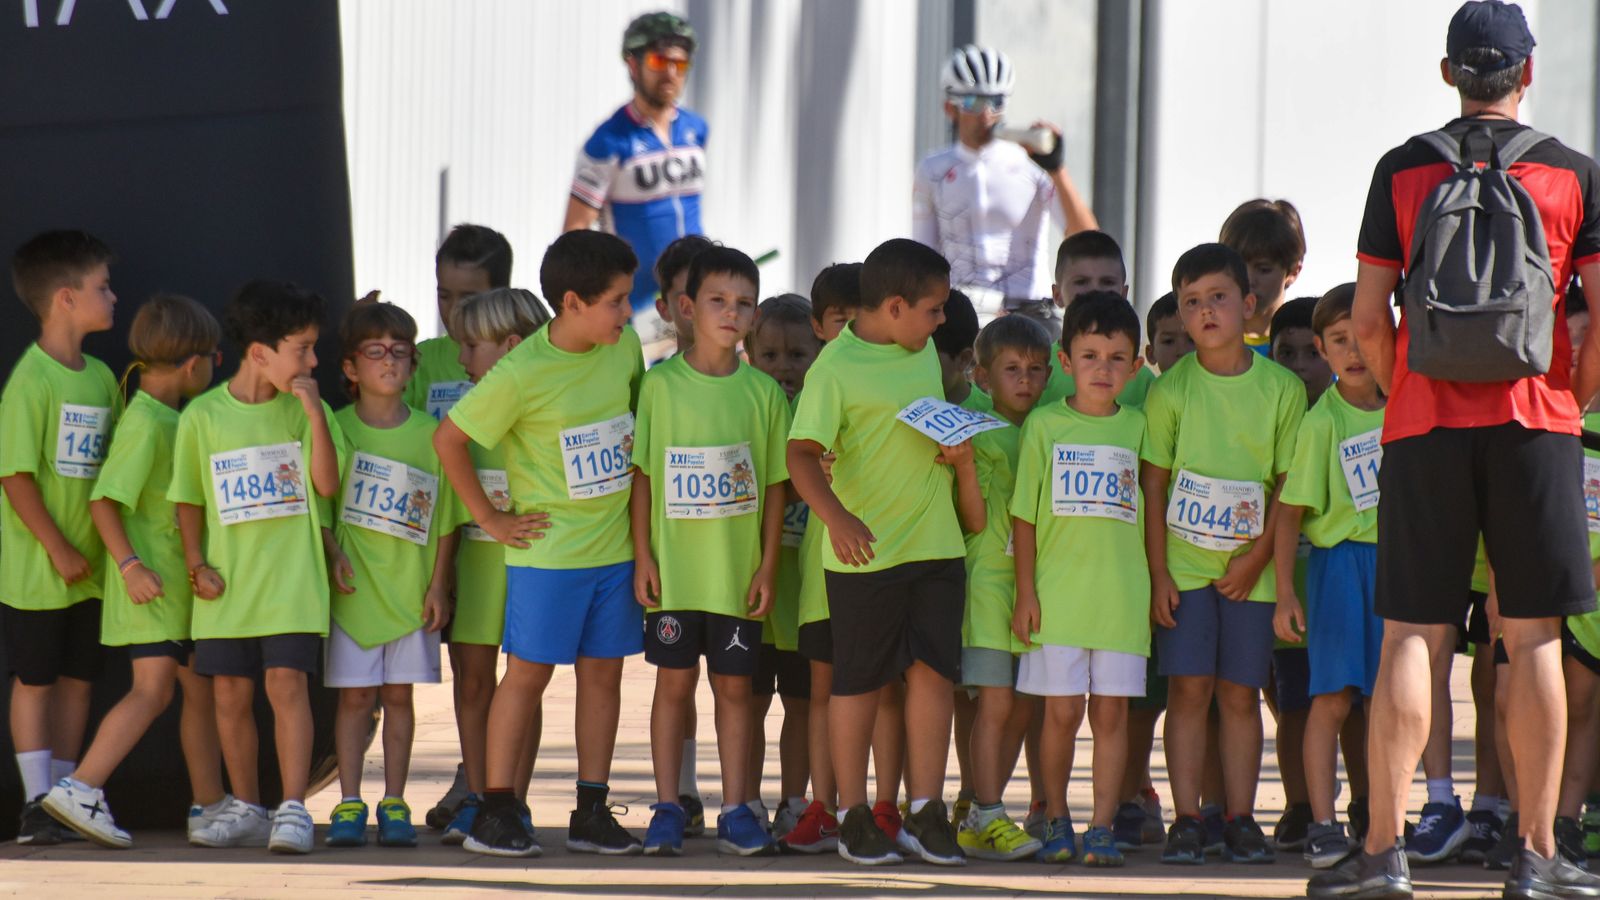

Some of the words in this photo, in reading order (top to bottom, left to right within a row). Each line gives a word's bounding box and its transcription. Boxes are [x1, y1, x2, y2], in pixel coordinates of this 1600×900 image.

[633, 155, 703, 190] UCA
[65, 411, 83, 424] XXI
[905, 408, 921, 422] XXI
[925, 407, 974, 434] 1075
[564, 433, 582, 448] XXI
[1058, 450, 1076, 461] XXI
[1344, 443, 1361, 458] XXI
[214, 459, 231, 472] XXI
[356, 459, 374, 473] XXI
[571, 444, 624, 480] 1105
[670, 453, 687, 465] XXI
[220, 471, 277, 504] 1484
[673, 472, 731, 499] 1036
[1060, 470, 1119, 498] 1078
[1179, 476, 1194, 491] XXI
[354, 479, 410, 517] 1134
[1177, 497, 1232, 531] 1044
